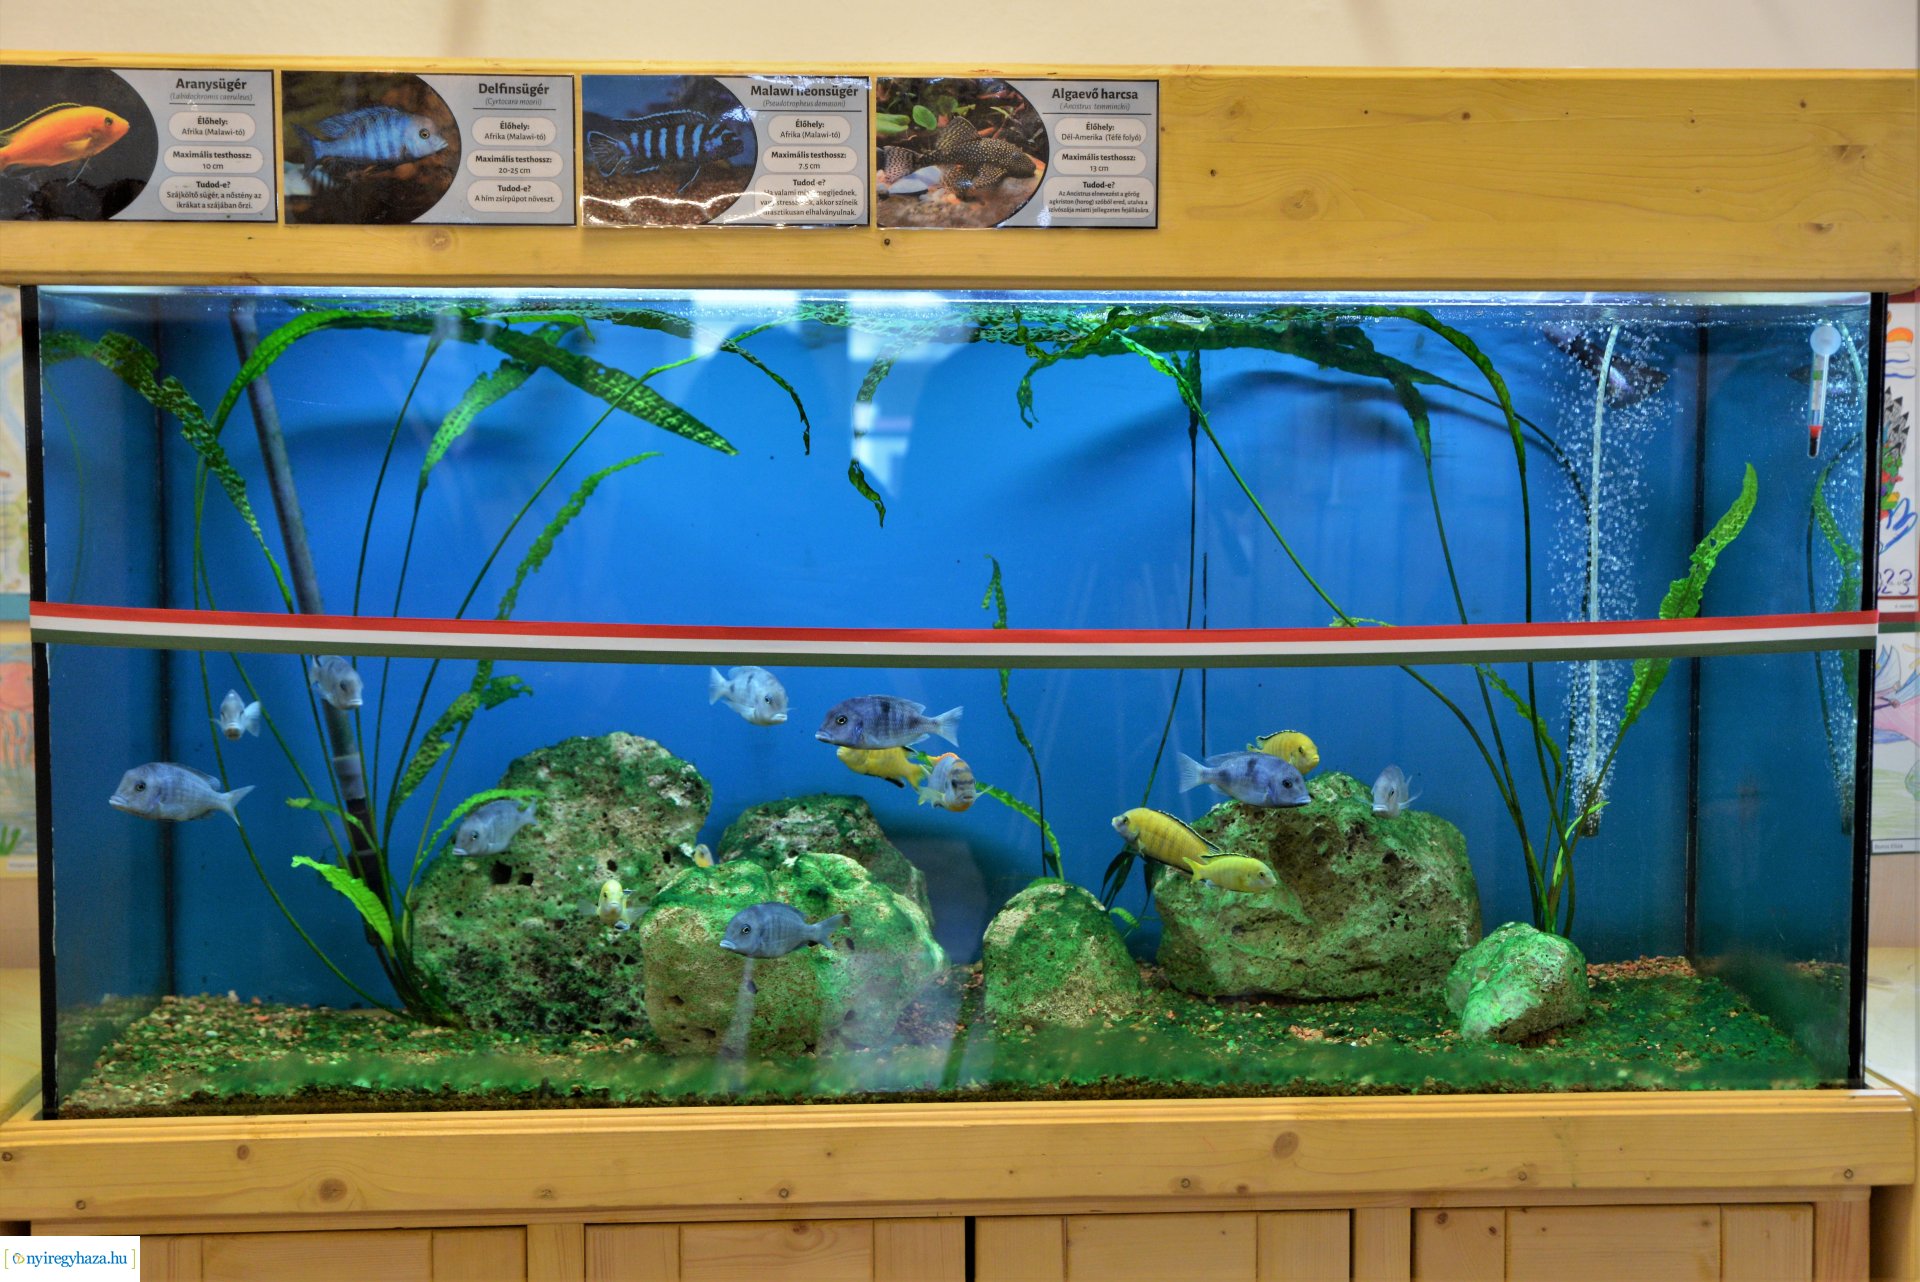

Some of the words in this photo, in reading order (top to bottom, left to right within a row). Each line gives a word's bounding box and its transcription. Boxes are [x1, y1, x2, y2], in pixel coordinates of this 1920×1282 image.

[176, 78, 247, 93] Aranysügér
[478, 83, 550, 97] Delfinsügér
[750, 85, 794, 96] Malawi
[797, 85, 858, 98] neonsügér
[1052, 88, 1098, 100] Algaevő
[1101, 88, 1138, 100] harcsa
[197, 116, 228, 126] Élőhely:
[795, 119, 825, 129] Élőhely:
[500, 120, 530, 131] Élőhely:
[1086, 122, 1114, 132] Élőhely:
[205, 128, 245, 136] (Malawi-tó)
[802, 131, 841, 139] (Malawi-tó)
[507, 133, 546, 141] (Malawi-tó)
[1122, 134, 1141, 142] folyó)
[214, 151, 251, 159] testhossz:
[476, 155, 514, 163] Maximális
[771, 151, 809, 159] Maximális
[498, 167, 518, 175] 20-25
[207, 202, 236, 210] szájában
